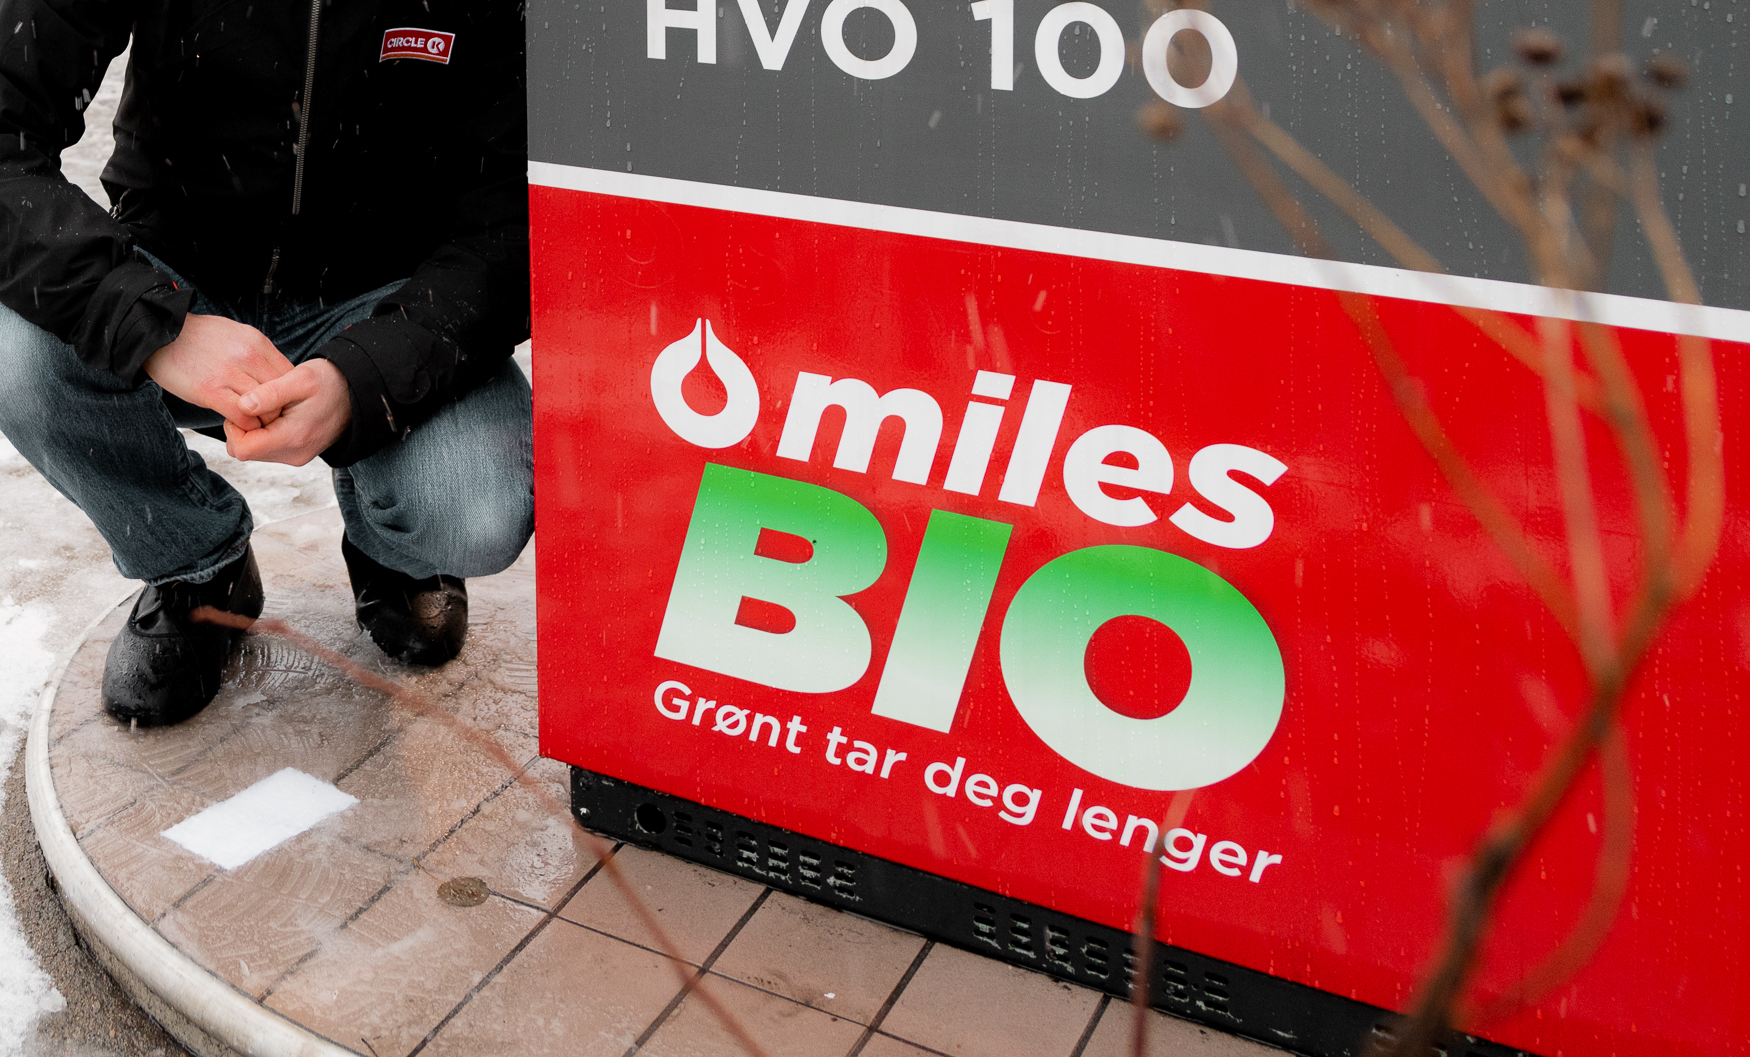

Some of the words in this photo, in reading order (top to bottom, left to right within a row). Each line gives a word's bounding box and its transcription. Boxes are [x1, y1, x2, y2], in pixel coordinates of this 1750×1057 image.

[387, 37, 425, 48] CIRCLE
[429, 38, 444, 53] K
[775, 369, 1289, 549] miles
[653, 461, 1286, 792] BIO
[653, 679, 807, 754] Grønt
[824, 726, 907, 779] tar
[924, 756, 1042, 826] deg
[1061, 787, 1283, 884] lenger
